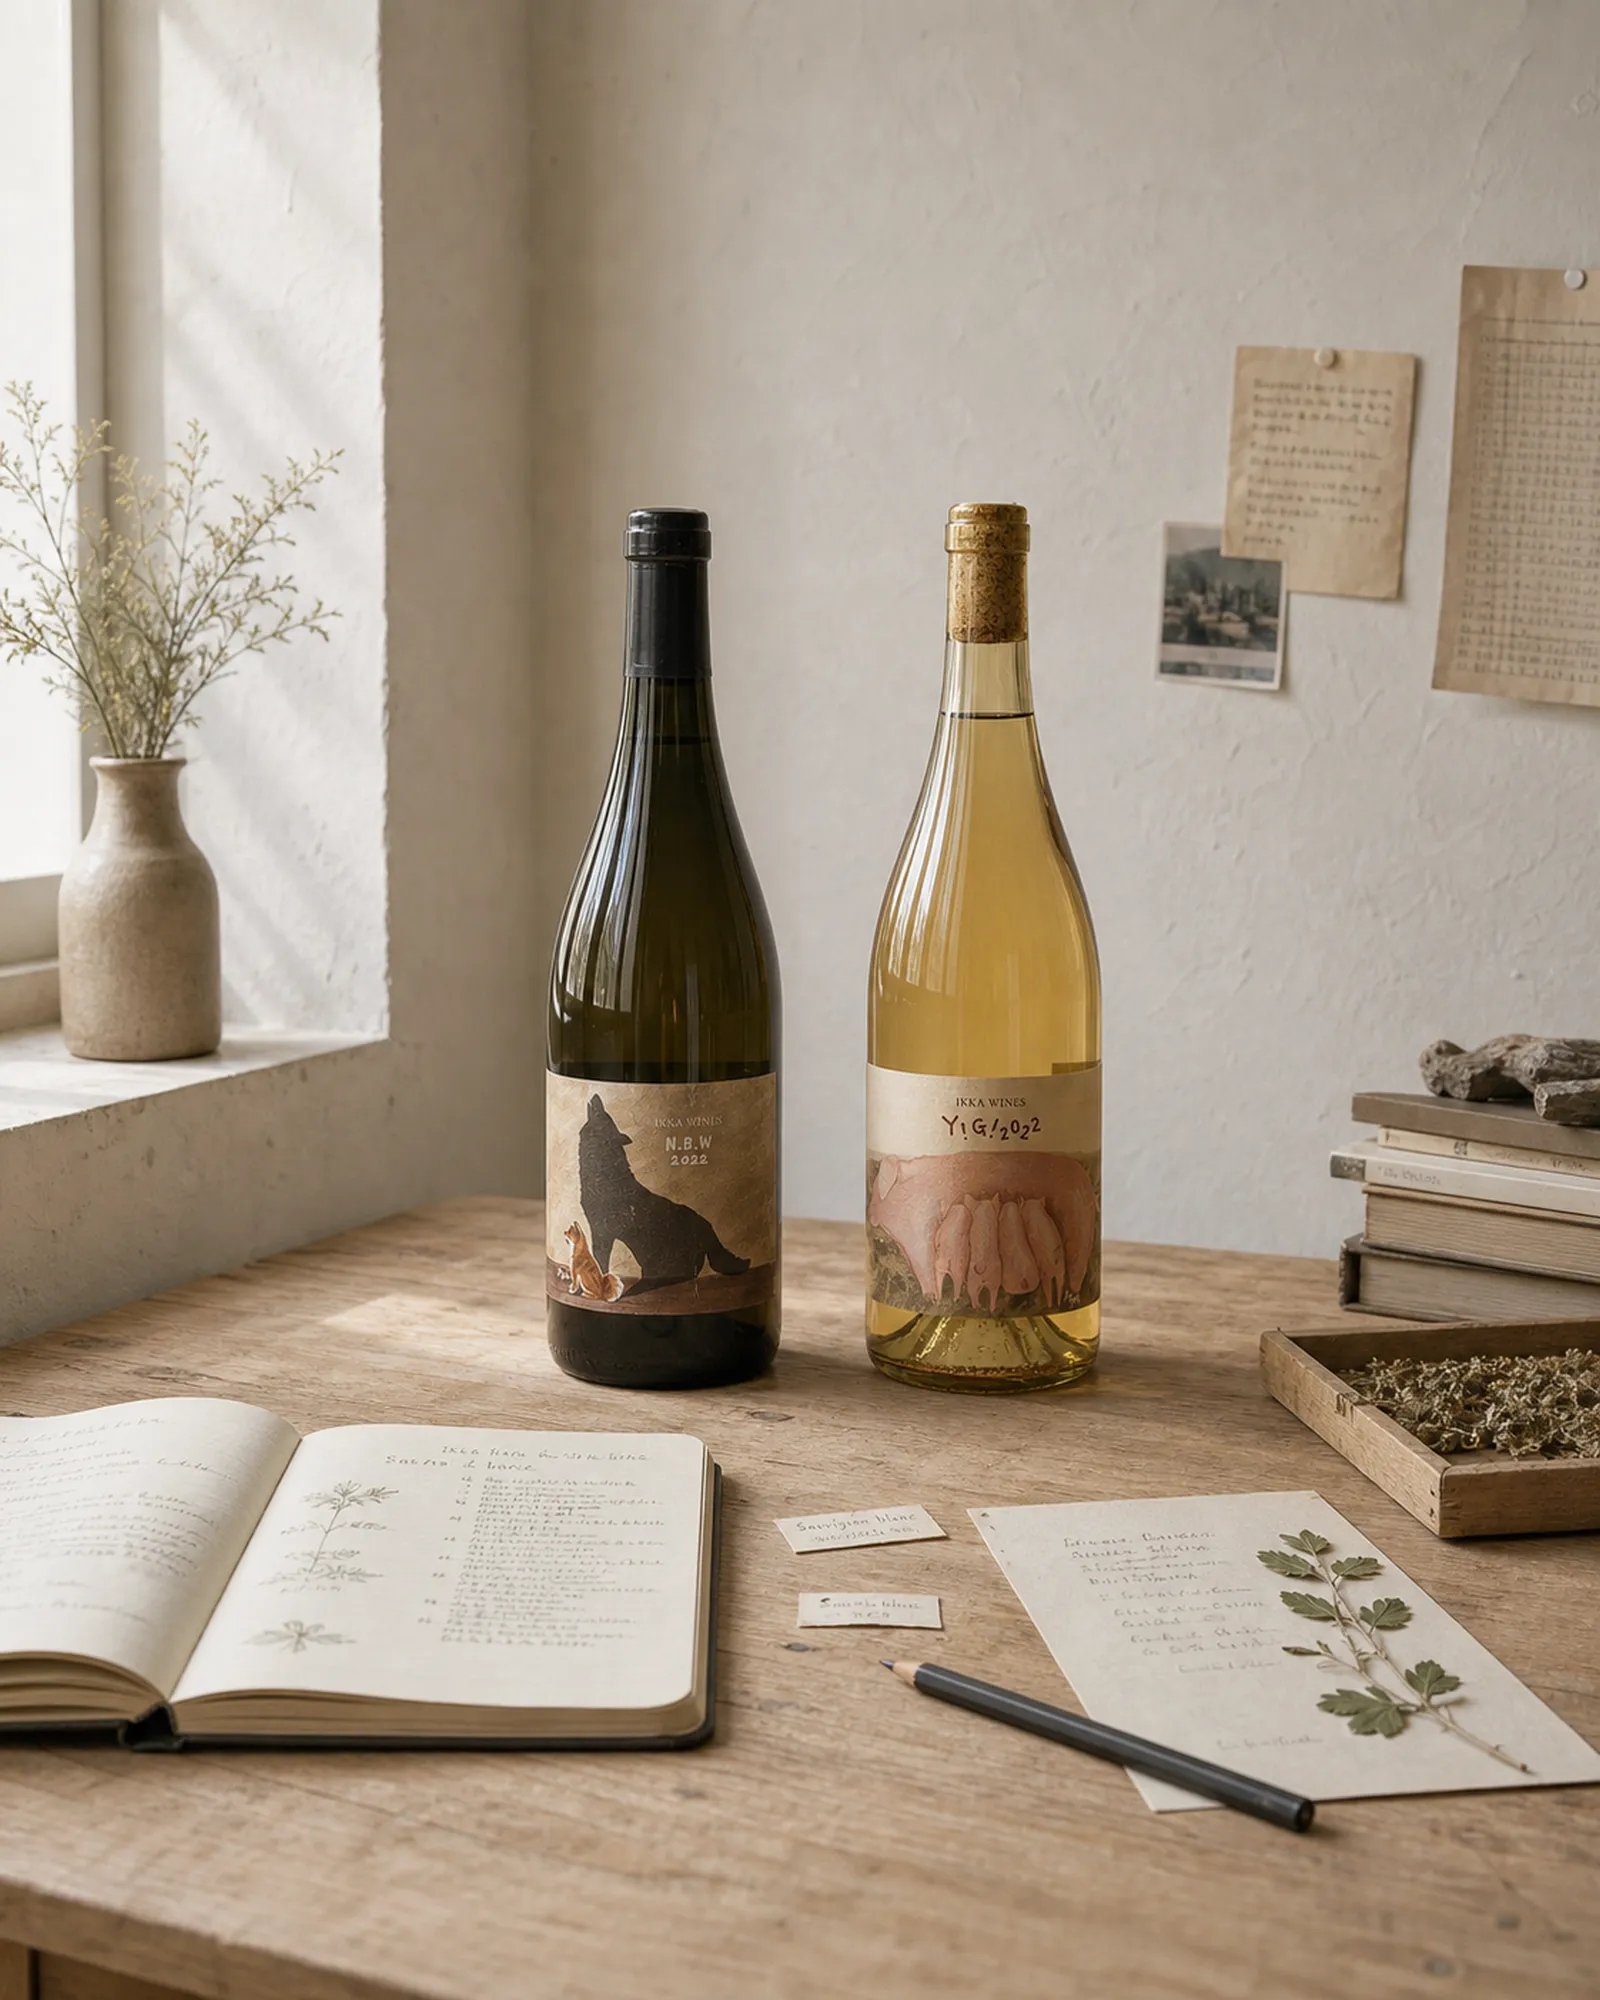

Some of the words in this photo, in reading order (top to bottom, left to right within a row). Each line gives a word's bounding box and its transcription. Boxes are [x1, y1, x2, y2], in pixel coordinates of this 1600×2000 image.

[956, 1097, 985, 1108] IKKA
[988, 1097, 1027, 1108] WINES
[665, 1135, 712, 1152] N.B.W
[670, 1154, 708, 1166] 2022
